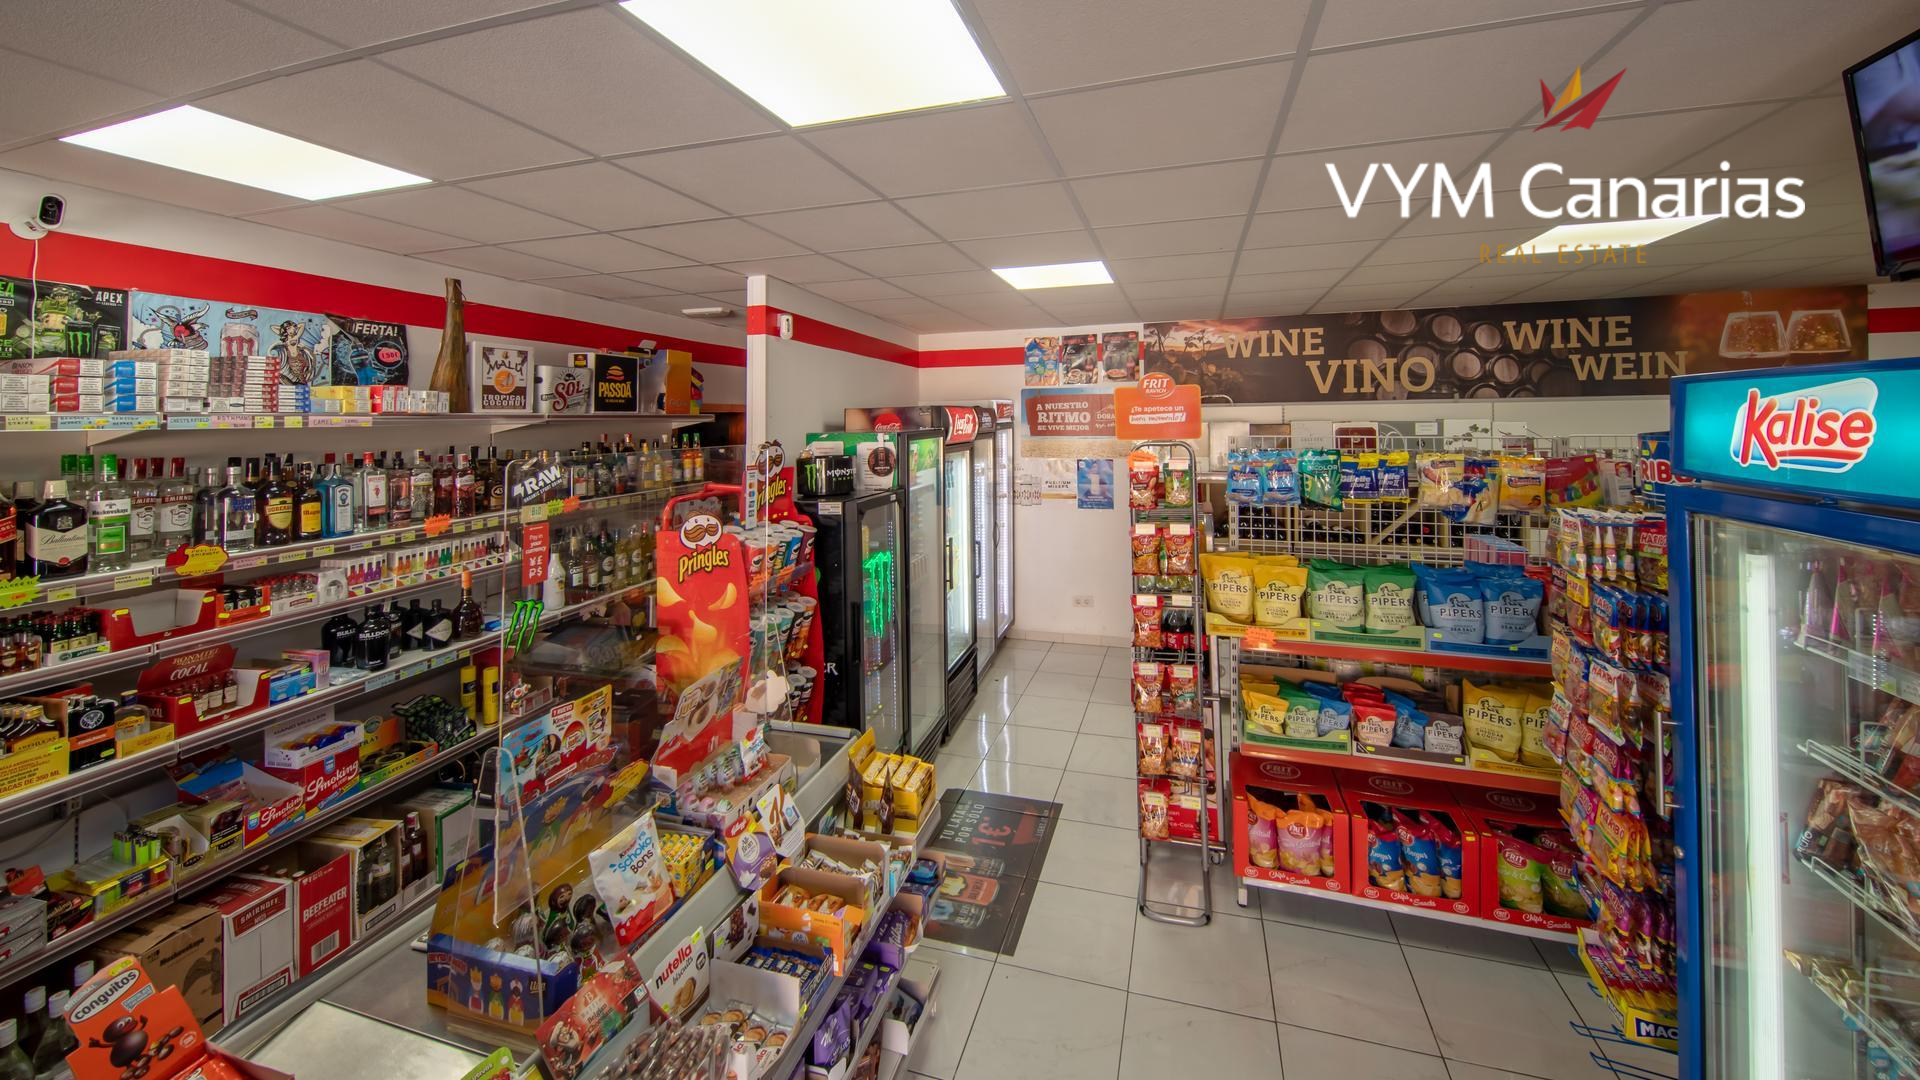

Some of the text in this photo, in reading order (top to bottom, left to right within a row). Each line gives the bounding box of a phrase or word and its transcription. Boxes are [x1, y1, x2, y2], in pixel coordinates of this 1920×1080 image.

[95, 291, 123, 304] APEX
[1224, 315, 1632, 359] WINE WINE
[1143, 378, 1170, 389] FRIT
[1306, 350, 1688, 394] VINO WEIN
[552, 380, 585, 412] SOL
[1036, 402, 1088, 411] A NUESTRO
[1037, 411, 1091, 423] RITMO
[1144, 406, 1172, 414] apetece
[1739, 389, 1875, 469] Kalise
[756, 476, 787, 512] ringles
[677, 545, 730, 583] Pringles
[1212, 583, 1248, 593] PIPERS
[1260, 591, 1297, 602] PIPERS
[1318, 594, 1359, 604] PIPERS
[1371, 597, 1411, 607] PIPERS
[1440, 608, 1482, 619] PIPERS
[170, 663, 209, 681] COCAL
[1253, 713, 1280, 723] PIPERS
[1287, 715, 1316, 725] PIPERS
[1361, 724, 1390, 735] PIPERS
[1466, 707, 1513, 727] PIPERS
[307, 759, 359, 801] Smoking
[261, 795, 303, 828] Smoking
[940, 809, 967, 840] TU LATA
[955, 803, 985, 843] POR SÓLO
[1601, 808, 1625, 840] HARIBO
[1289, 824, 1304, 833] FRIT
[617, 834, 654, 874] Schoko
[630, 848, 655, 875] Bons
[1504, 851, 1524, 864] FRIT
[240, 899, 280, 926] SMIRNOFF
[303, 885, 348, 924] BEEFEATER
[655, 943, 693, 990] nutella
[672, 956, 693, 986] biscuits
[74, 971, 138, 1022] conguitos
